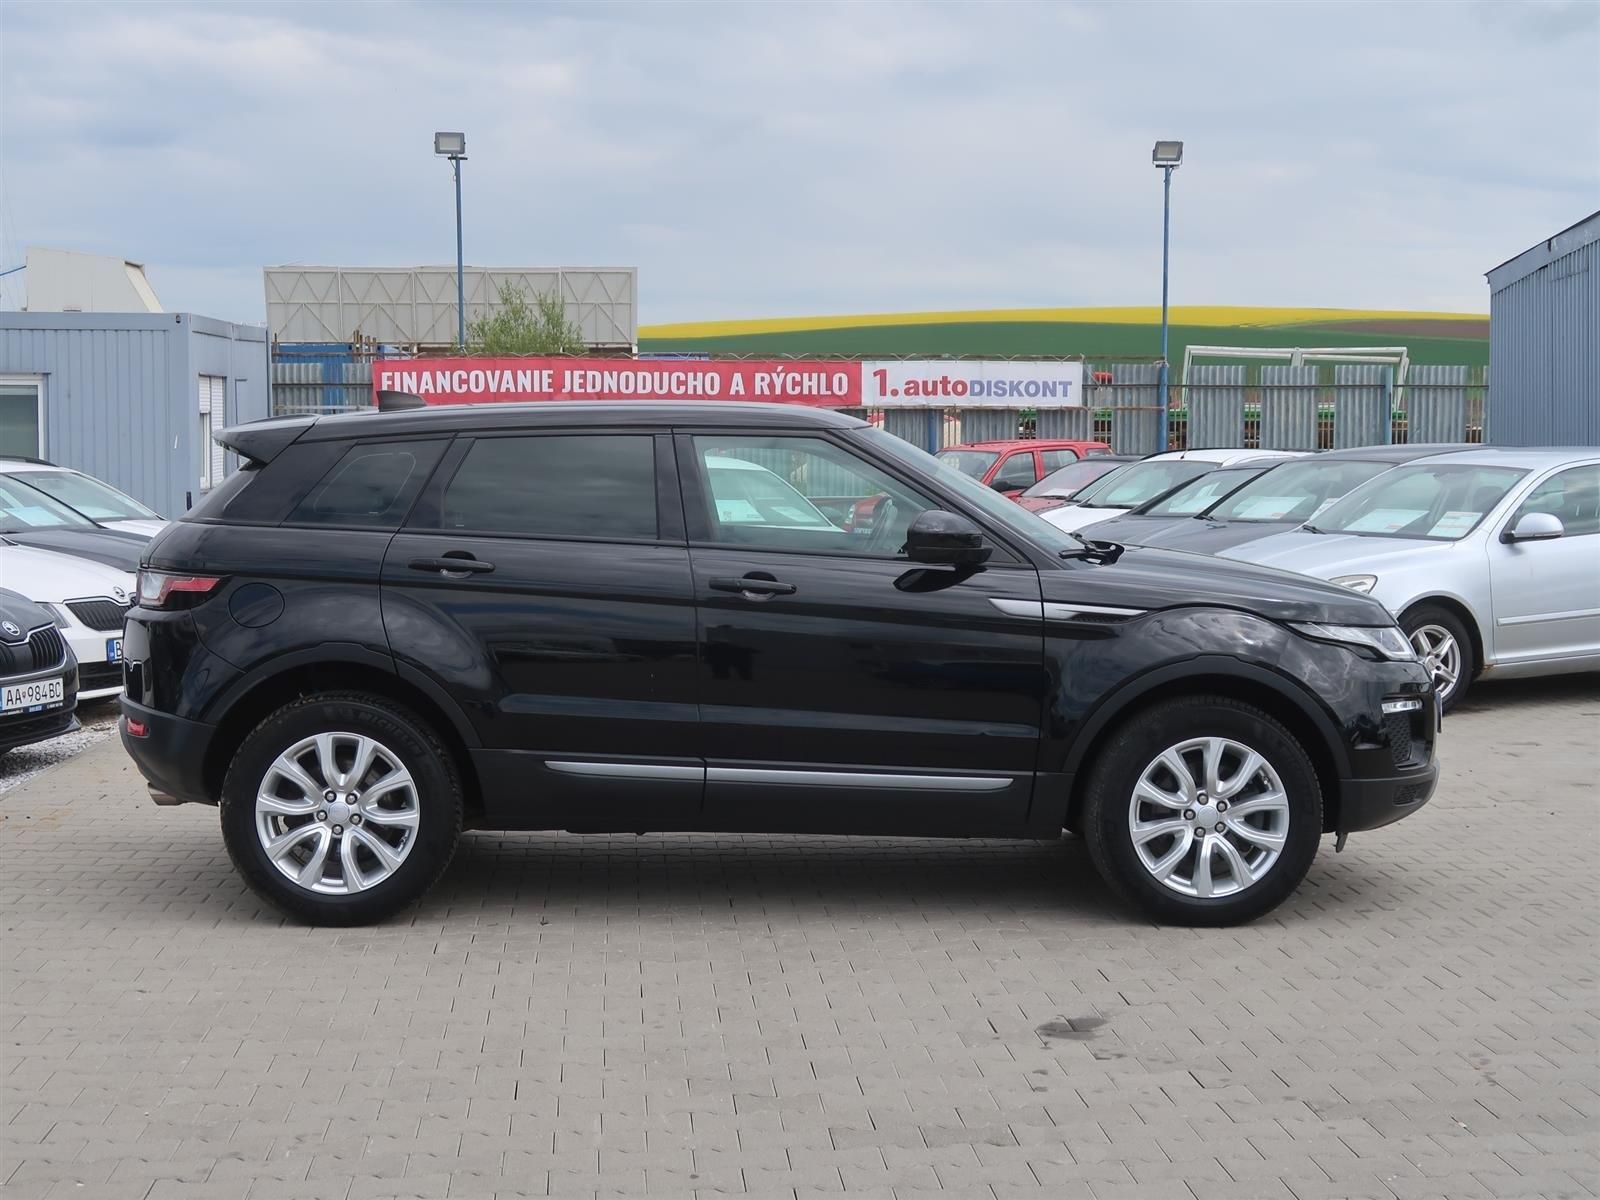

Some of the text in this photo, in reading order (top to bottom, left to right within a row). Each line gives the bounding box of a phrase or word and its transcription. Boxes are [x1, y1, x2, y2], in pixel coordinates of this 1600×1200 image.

[381, 365, 848, 396] FINANCOVANIE JEDNODUCHO A RÝCHLO
